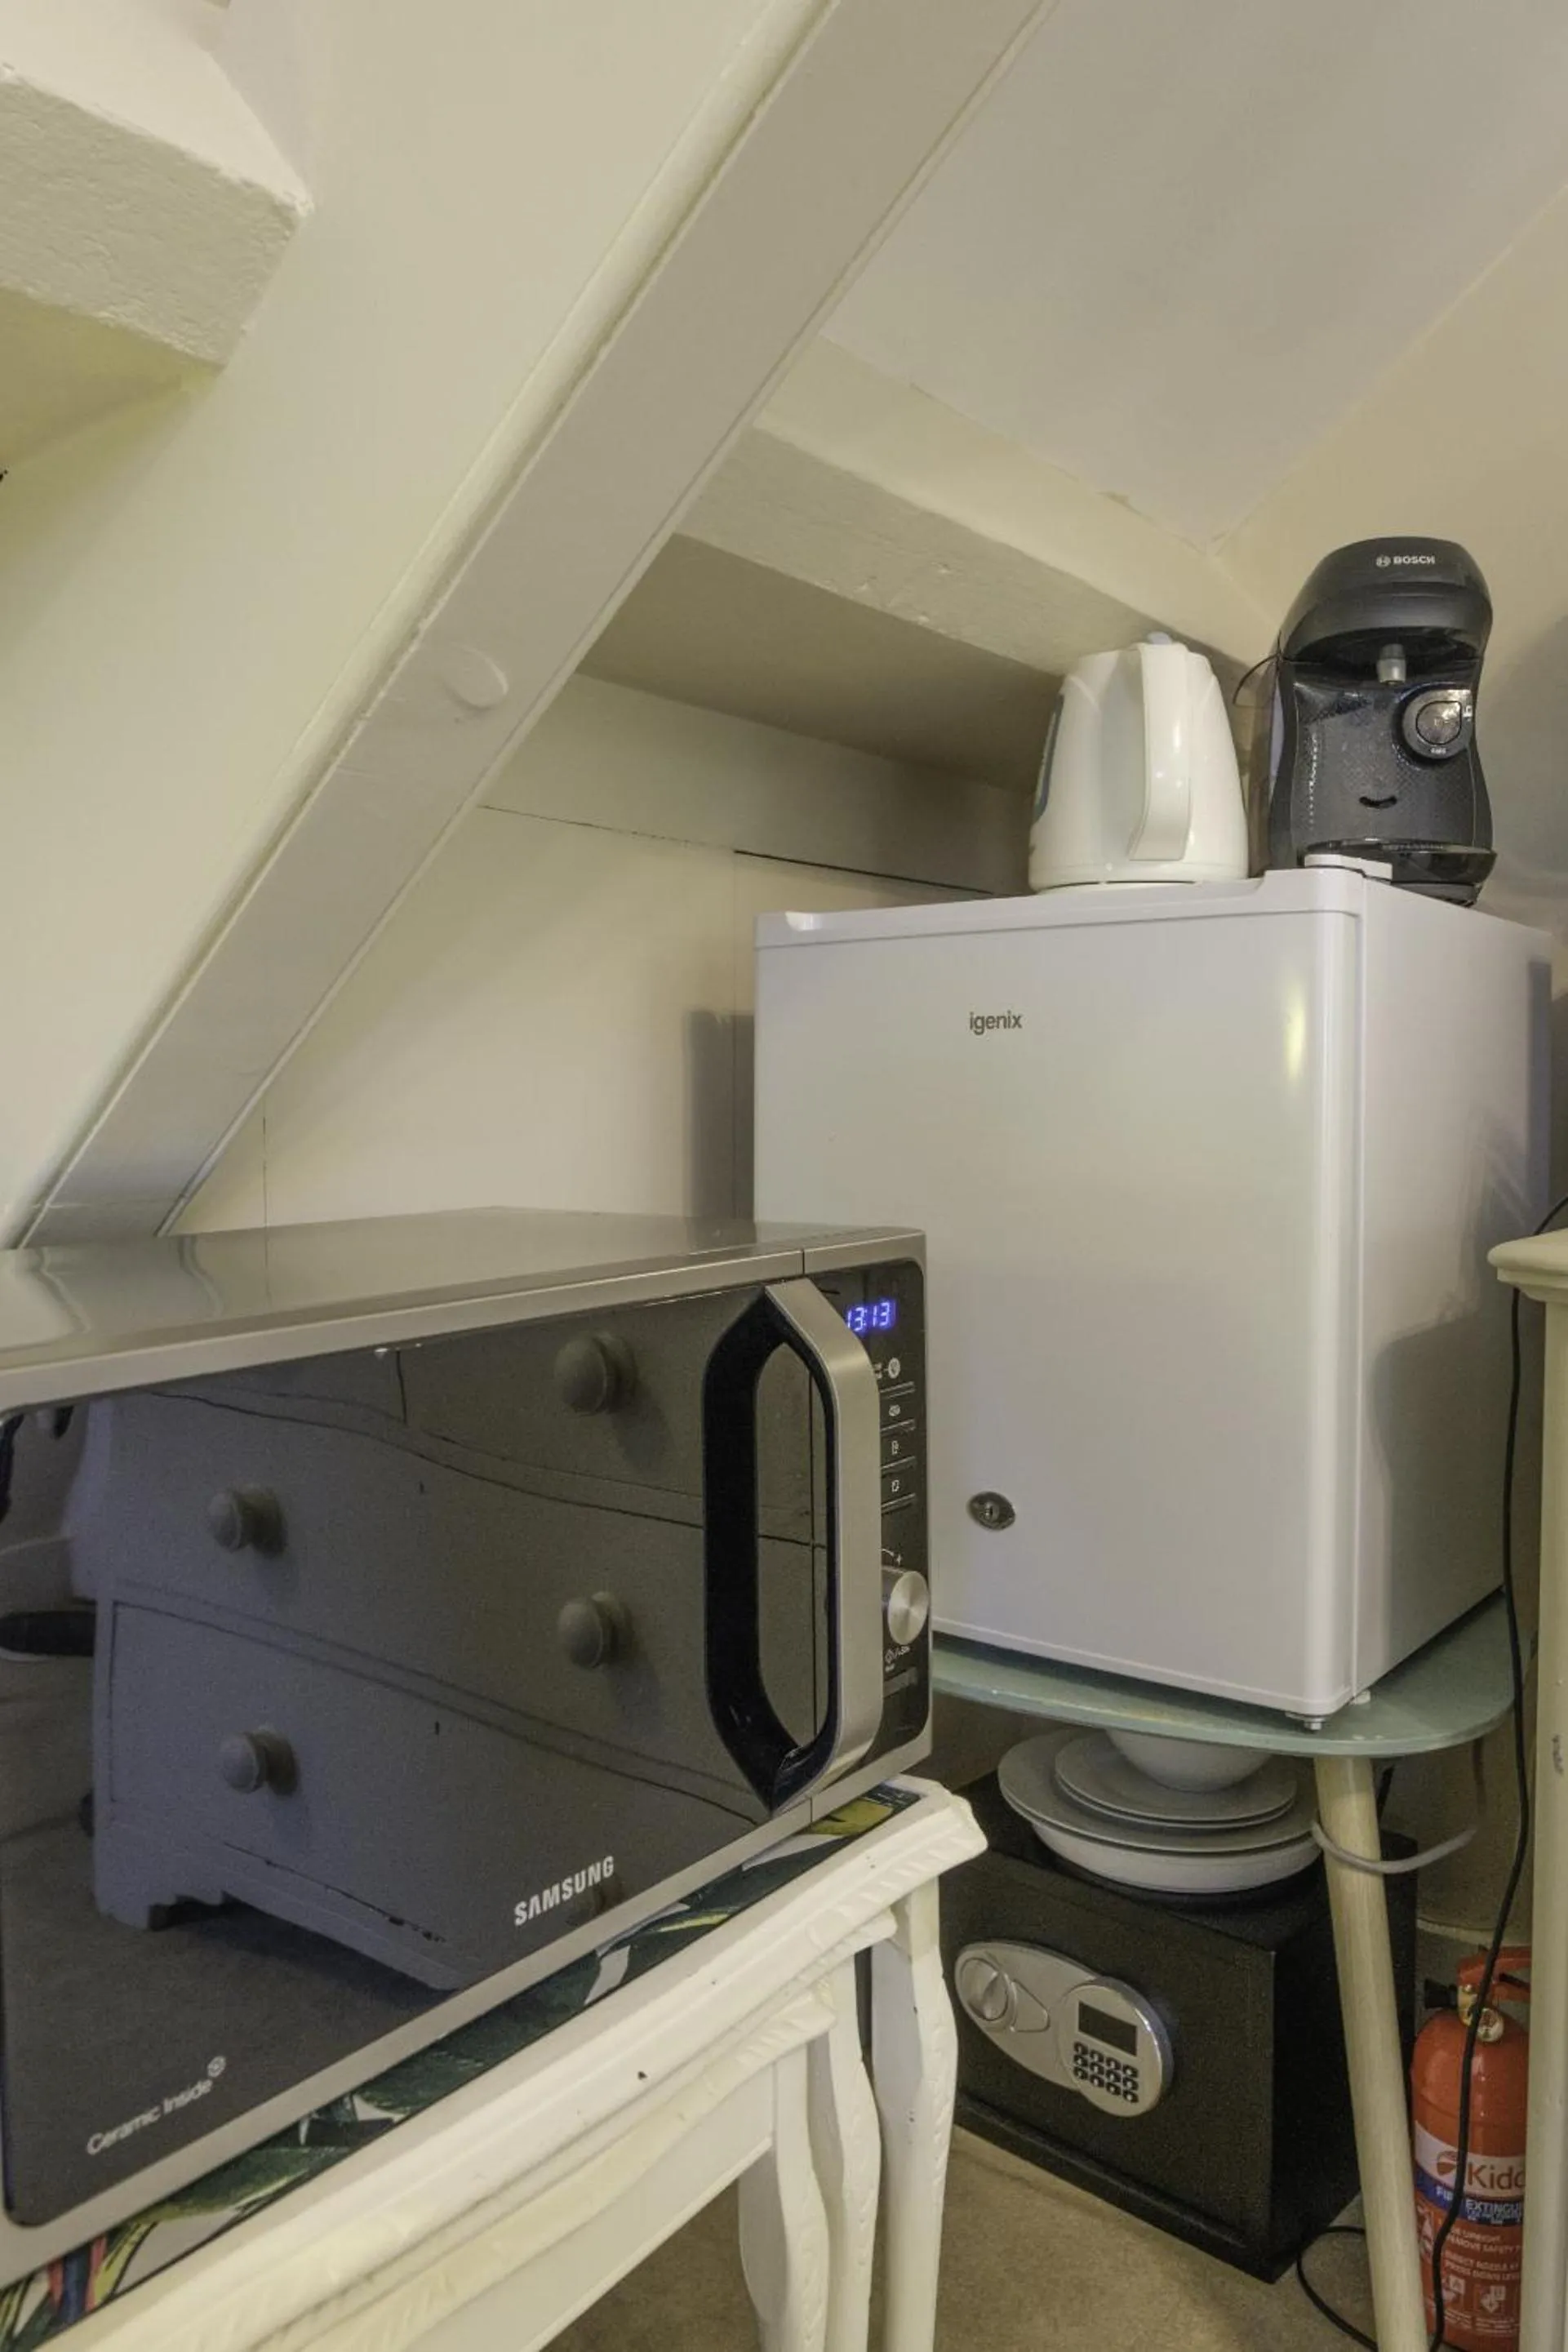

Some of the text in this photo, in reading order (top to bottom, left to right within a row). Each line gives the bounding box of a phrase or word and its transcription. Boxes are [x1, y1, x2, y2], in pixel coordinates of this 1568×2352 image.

[1393, 555, 1436, 565] BOSCH
[969, 1009, 1023, 1036] igenix
[513, 1855, 614, 1927] SAMSUNG
